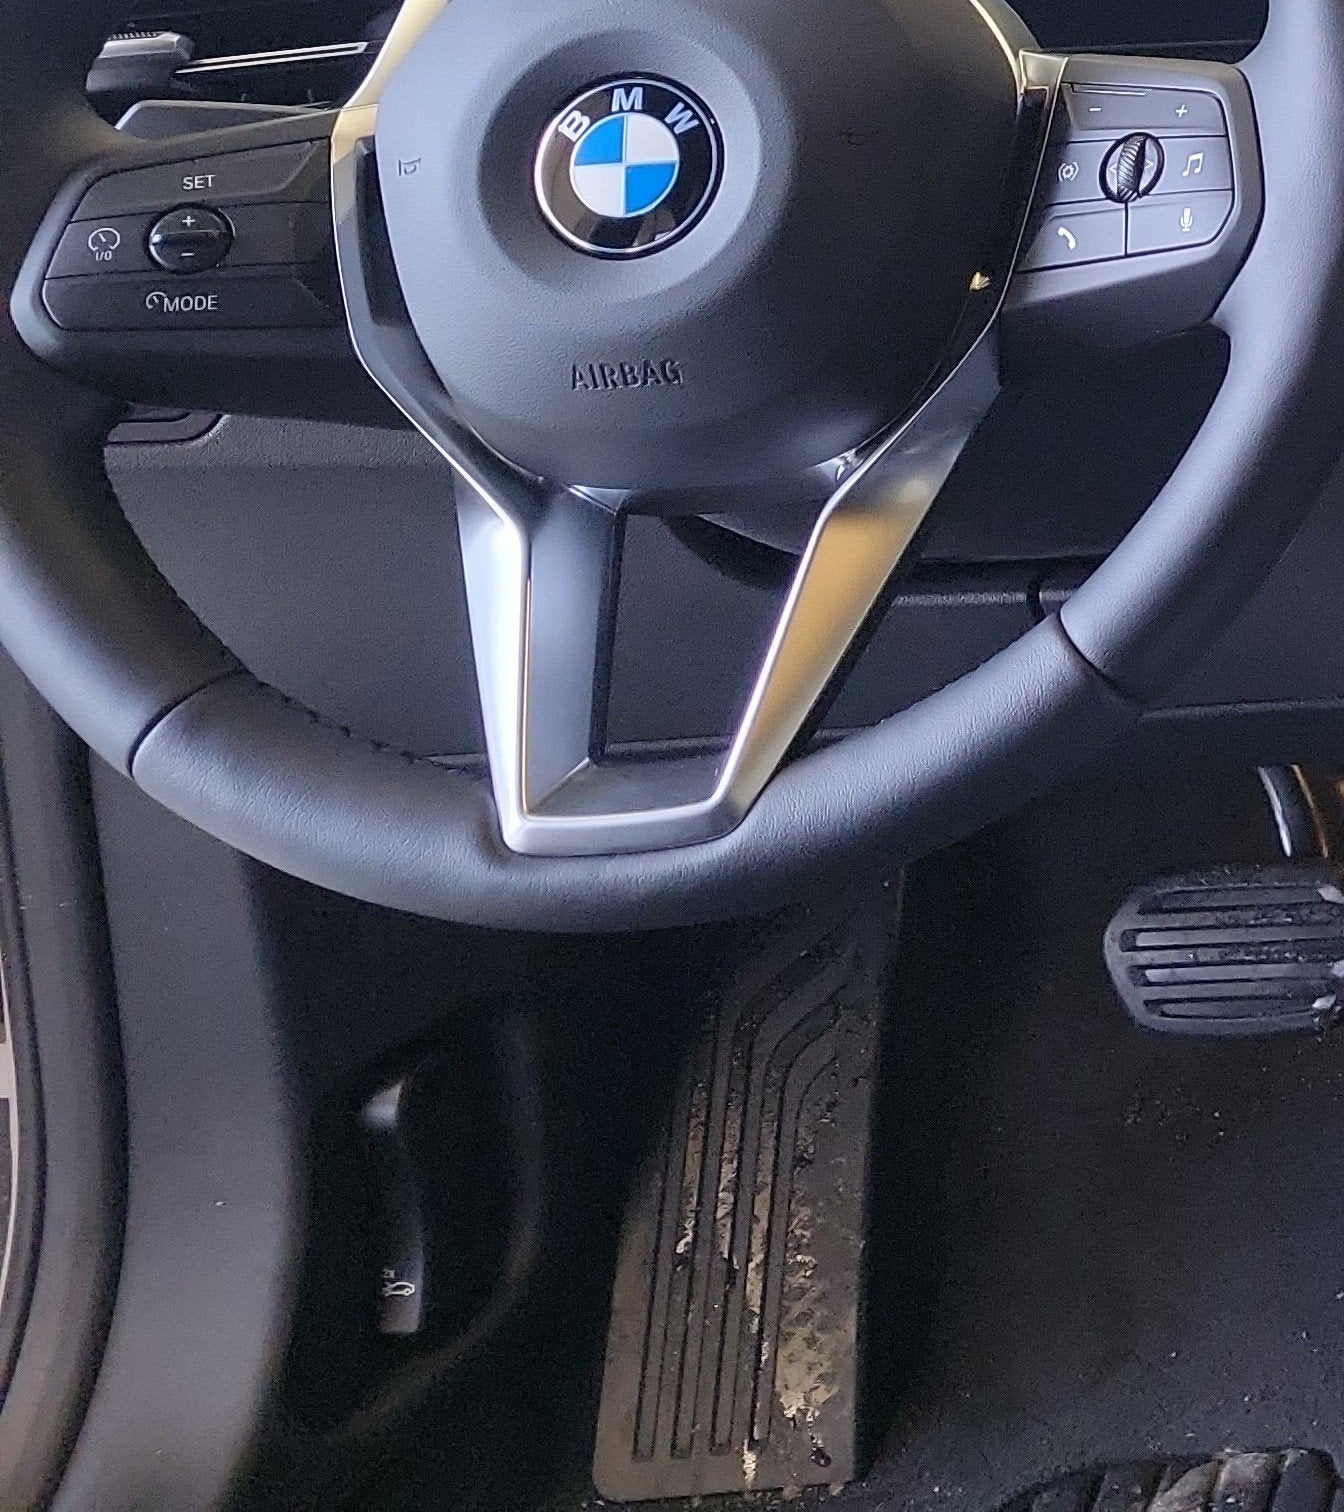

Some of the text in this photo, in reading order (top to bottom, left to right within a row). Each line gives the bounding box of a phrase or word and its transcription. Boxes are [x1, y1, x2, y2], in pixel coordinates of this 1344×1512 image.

[557, 86, 701, 143] BMW
[183, 174, 216, 190] SET
[163, 294, 218, 312] MODE
[571, 358, 684, 390] AIRBAG
